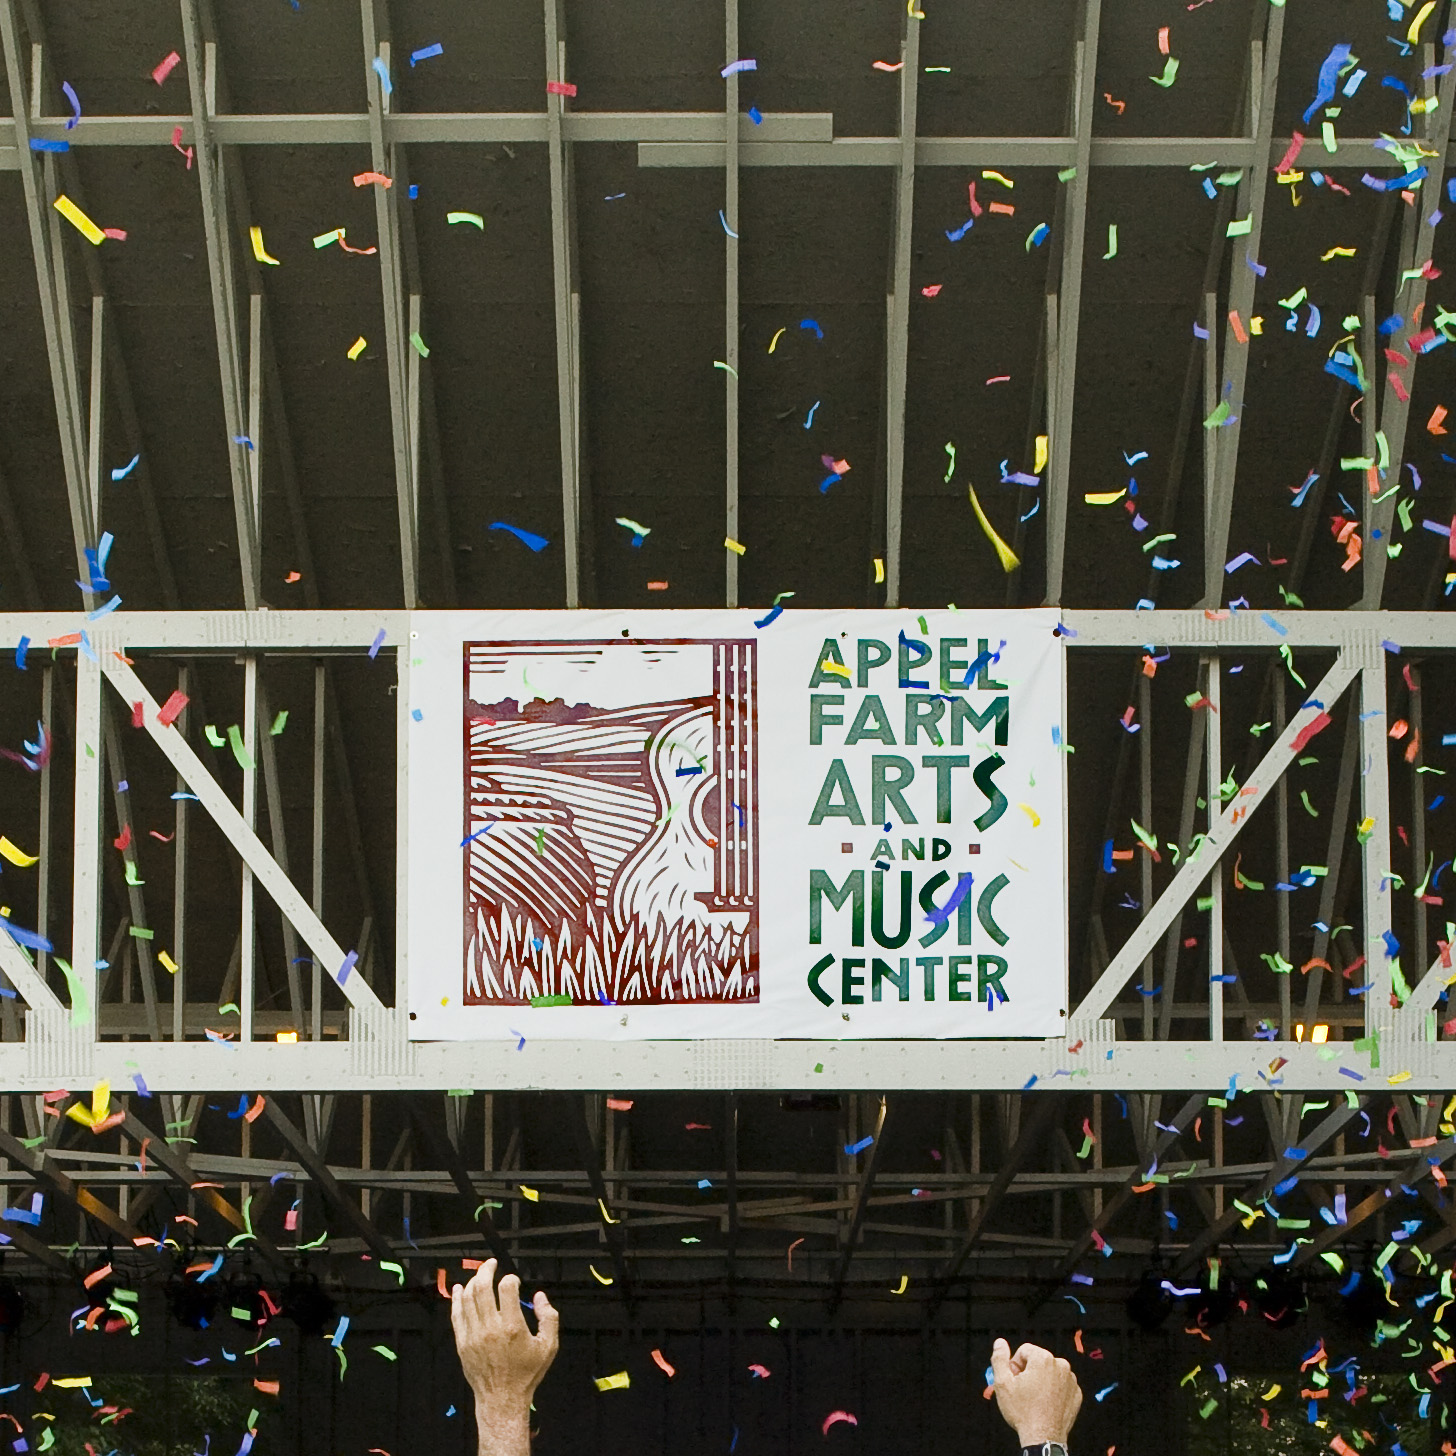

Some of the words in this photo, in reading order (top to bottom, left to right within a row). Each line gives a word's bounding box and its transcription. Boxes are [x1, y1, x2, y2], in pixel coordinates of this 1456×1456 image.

[808, 638, 1010, 690] APPEL
[808, 693, 1010, 746] FARM
[808, 754, 1010, 832] ARTS
[870, 837, 953, 862] AND
[808, 868, 1011, 950] MUSIC
[807, 953, 1011, 1007] CENTER
